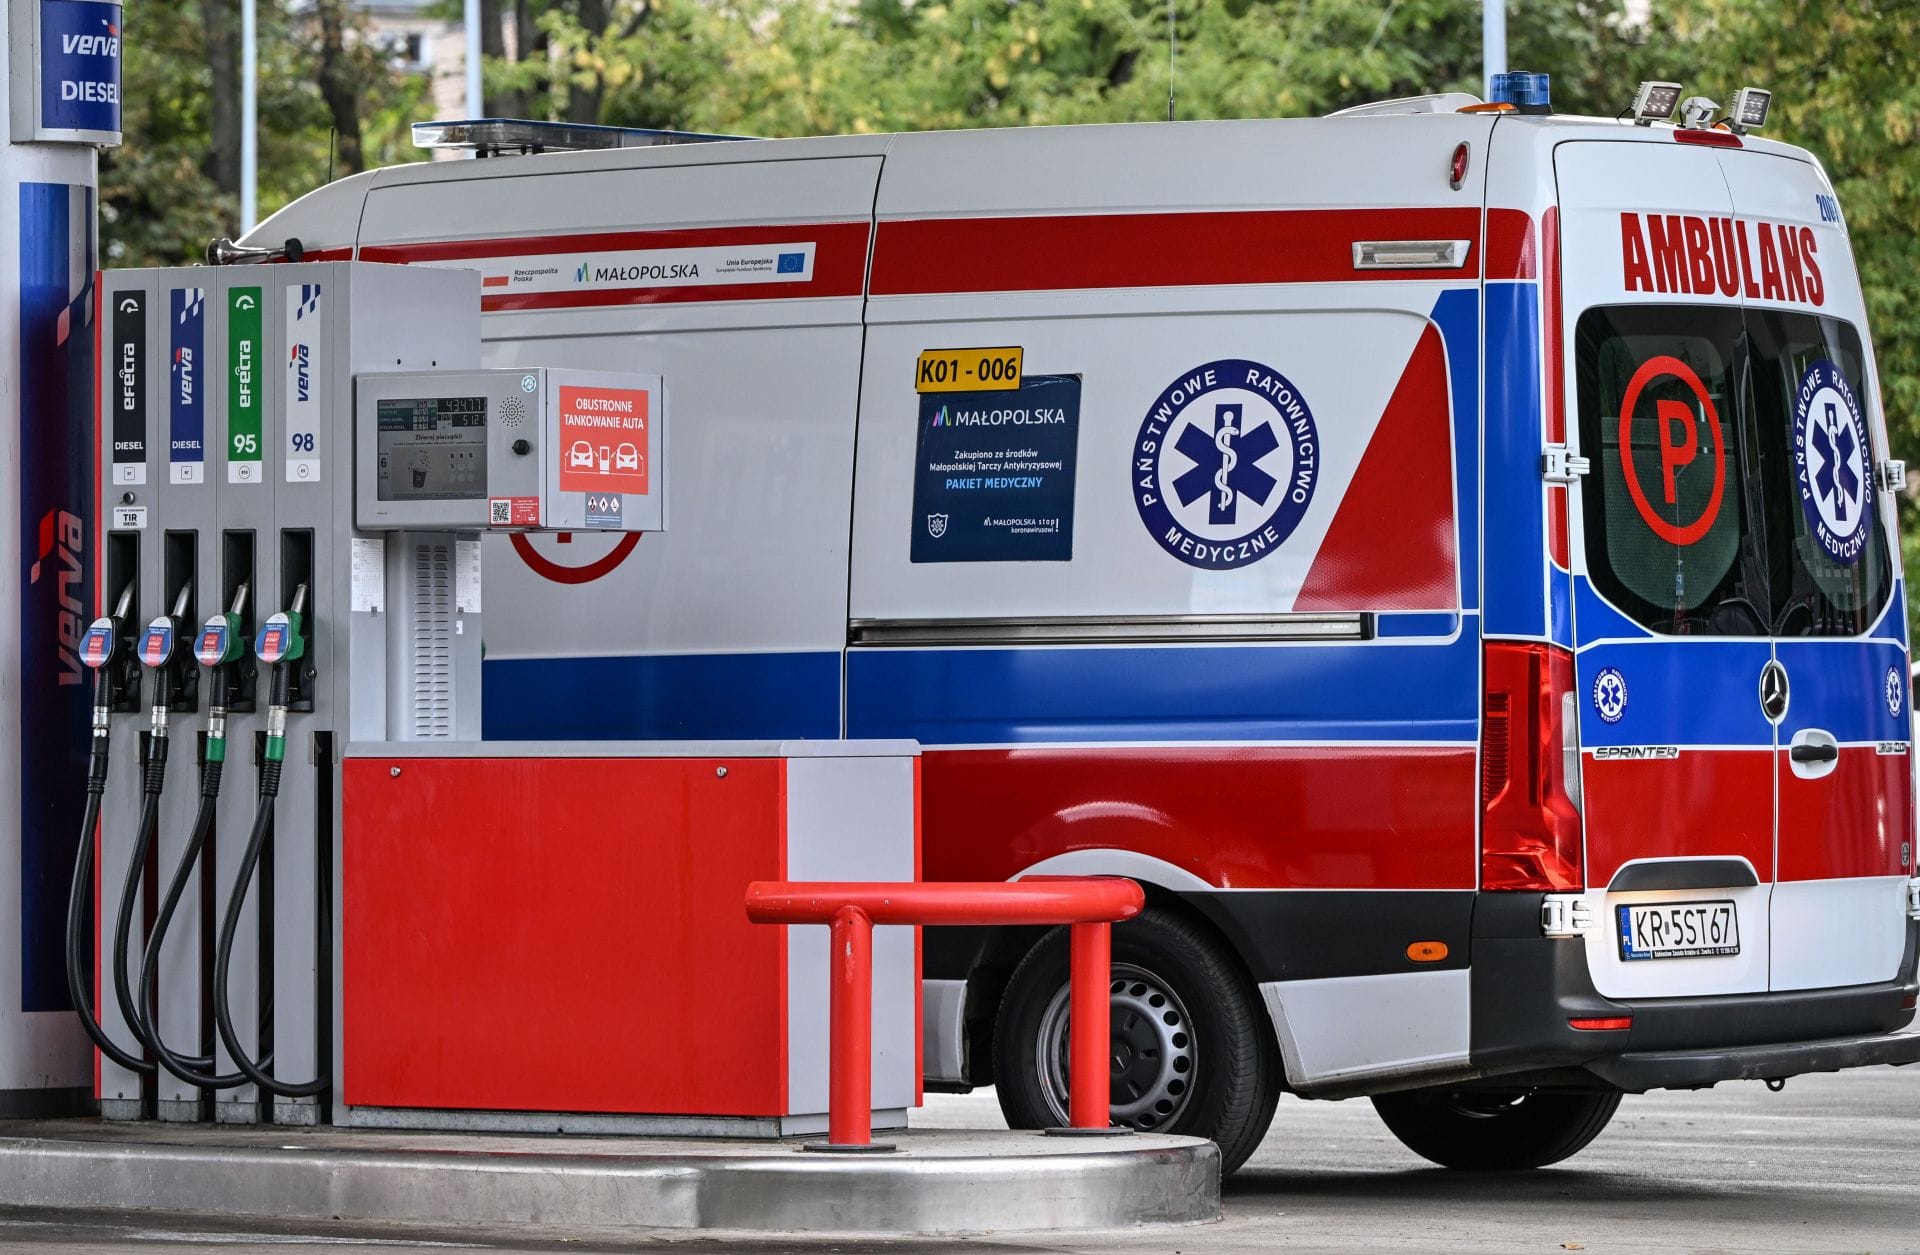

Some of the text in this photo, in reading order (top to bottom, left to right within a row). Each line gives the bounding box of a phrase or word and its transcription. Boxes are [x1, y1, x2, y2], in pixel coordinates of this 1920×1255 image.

[62, 34, 117, 57] verva
[62, 80, 118, 104] DIESEL
[741, 258, 773, 266] Europejska
[1620, 212, 1825, 307] AMBULANS
[514, 268, 558, 276] Rzeczpospolita
[595, 264, 699, 282] MAŁOPOLSKA
[181, 347, 192, 405] verva
[298, 344, 309, 402] verva
[920, 360, 958, 383] K01
[978, 358, 1016, 382] 006
[576, 398, 633, 412] OBUSTRONNE
[564, 414, 644, 430] TANKOWANIE AUTA
[956, 408, 1065, 426] MAŁOPOLSKA
[115, 442, 143, 450] DIESEL
[172, 440, 201, 449] DIESEL
[234, 434, 257, 453] 95
[292, 433, 314, 452] 98
[1656, 399, 1698, 504] P
[381, 458, 387, 468] 6
[954, 450, 992, 460] Zakupiono
[1005, 448, 1038, 458] środków
[1796, 368, 1872, 558] PAŃSTWOWE RATOWNICTWO MEDYCZNE
[929, 460, 1062, 472] Małopolskiej Tarczy Antykryzysowej
[1137, 369, 1314, 562] PAŃSTWOWE RATOWNICTWO MEDYCZNE
[946, 477, 1043, 489] PAKIET MEDYCZNY
[123, 513, 137, 521] TIR
[993, 518, 1055, 526] MAŁOPOLSKA stop
[59, 509, 82, 687] verva
[1595, 746, 1678, 758] SPRINTER
[1636, 908, 1730, 947] KR 5ST67
[1623, 935, 1631, 945] PL
